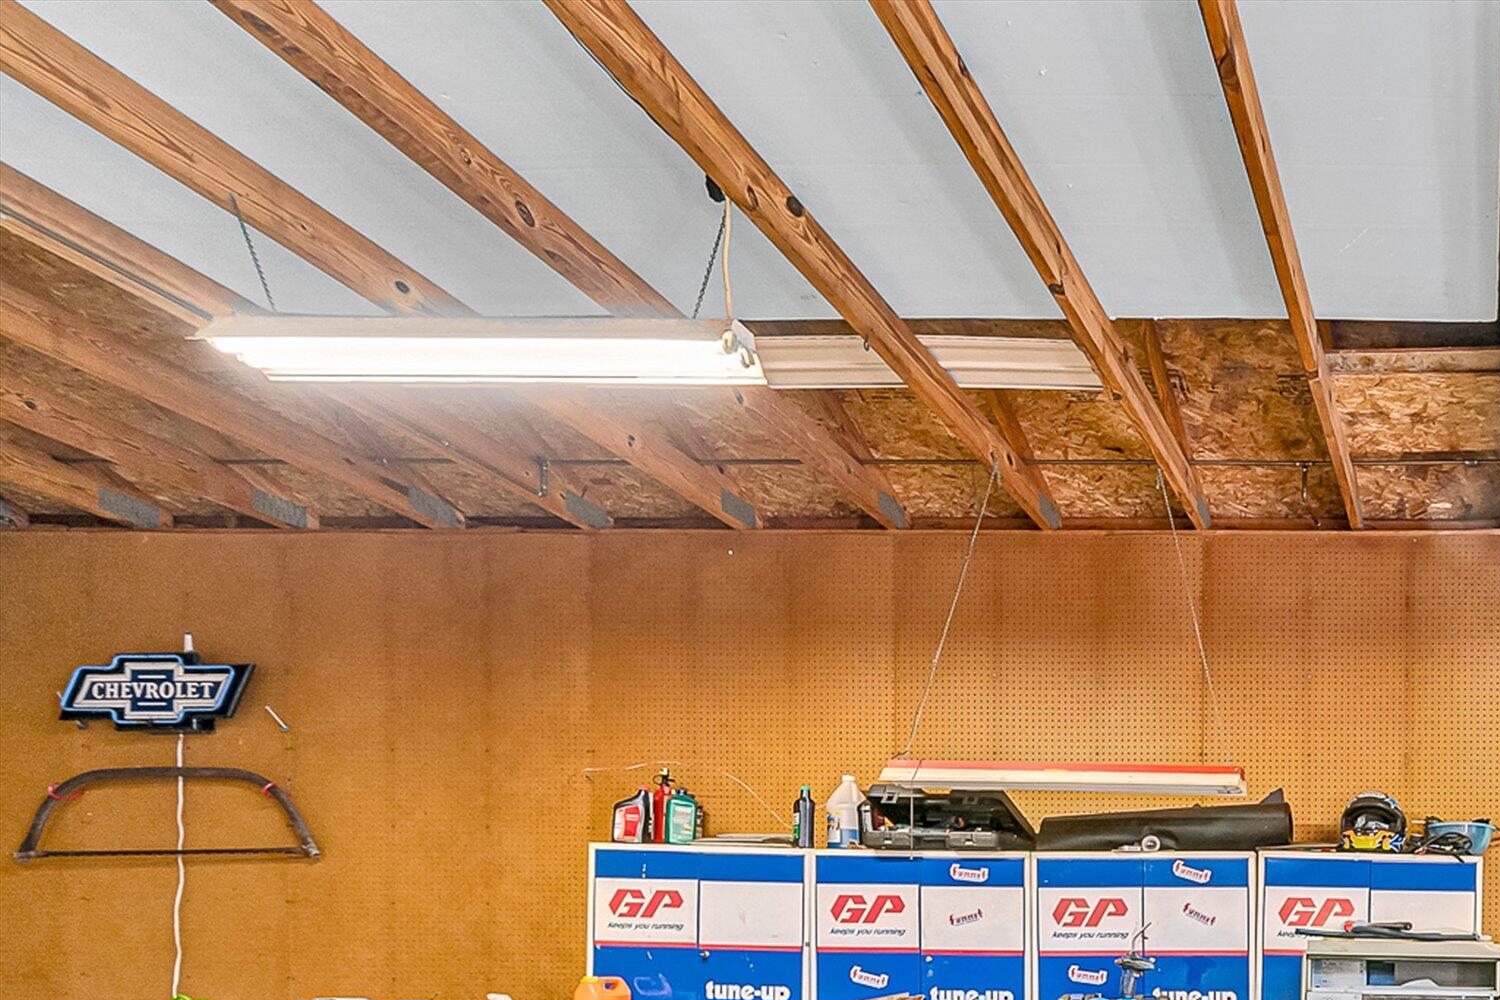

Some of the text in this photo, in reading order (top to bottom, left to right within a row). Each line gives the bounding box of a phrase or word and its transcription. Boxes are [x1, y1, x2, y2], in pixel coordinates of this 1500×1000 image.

[91, 681, 214, 699] CHEVROLET
[608, 888, 684, 918] GP
[829, 895, 906, 923] GP
[1052, 898, 1129, 927] GP
[1278, 897, 1355, 926] GP
[607, 921, 684, 931] keeps you running
[830, 927, 906, 937] keeps you running
[1052, 931, 1129, 940] keeps you running
